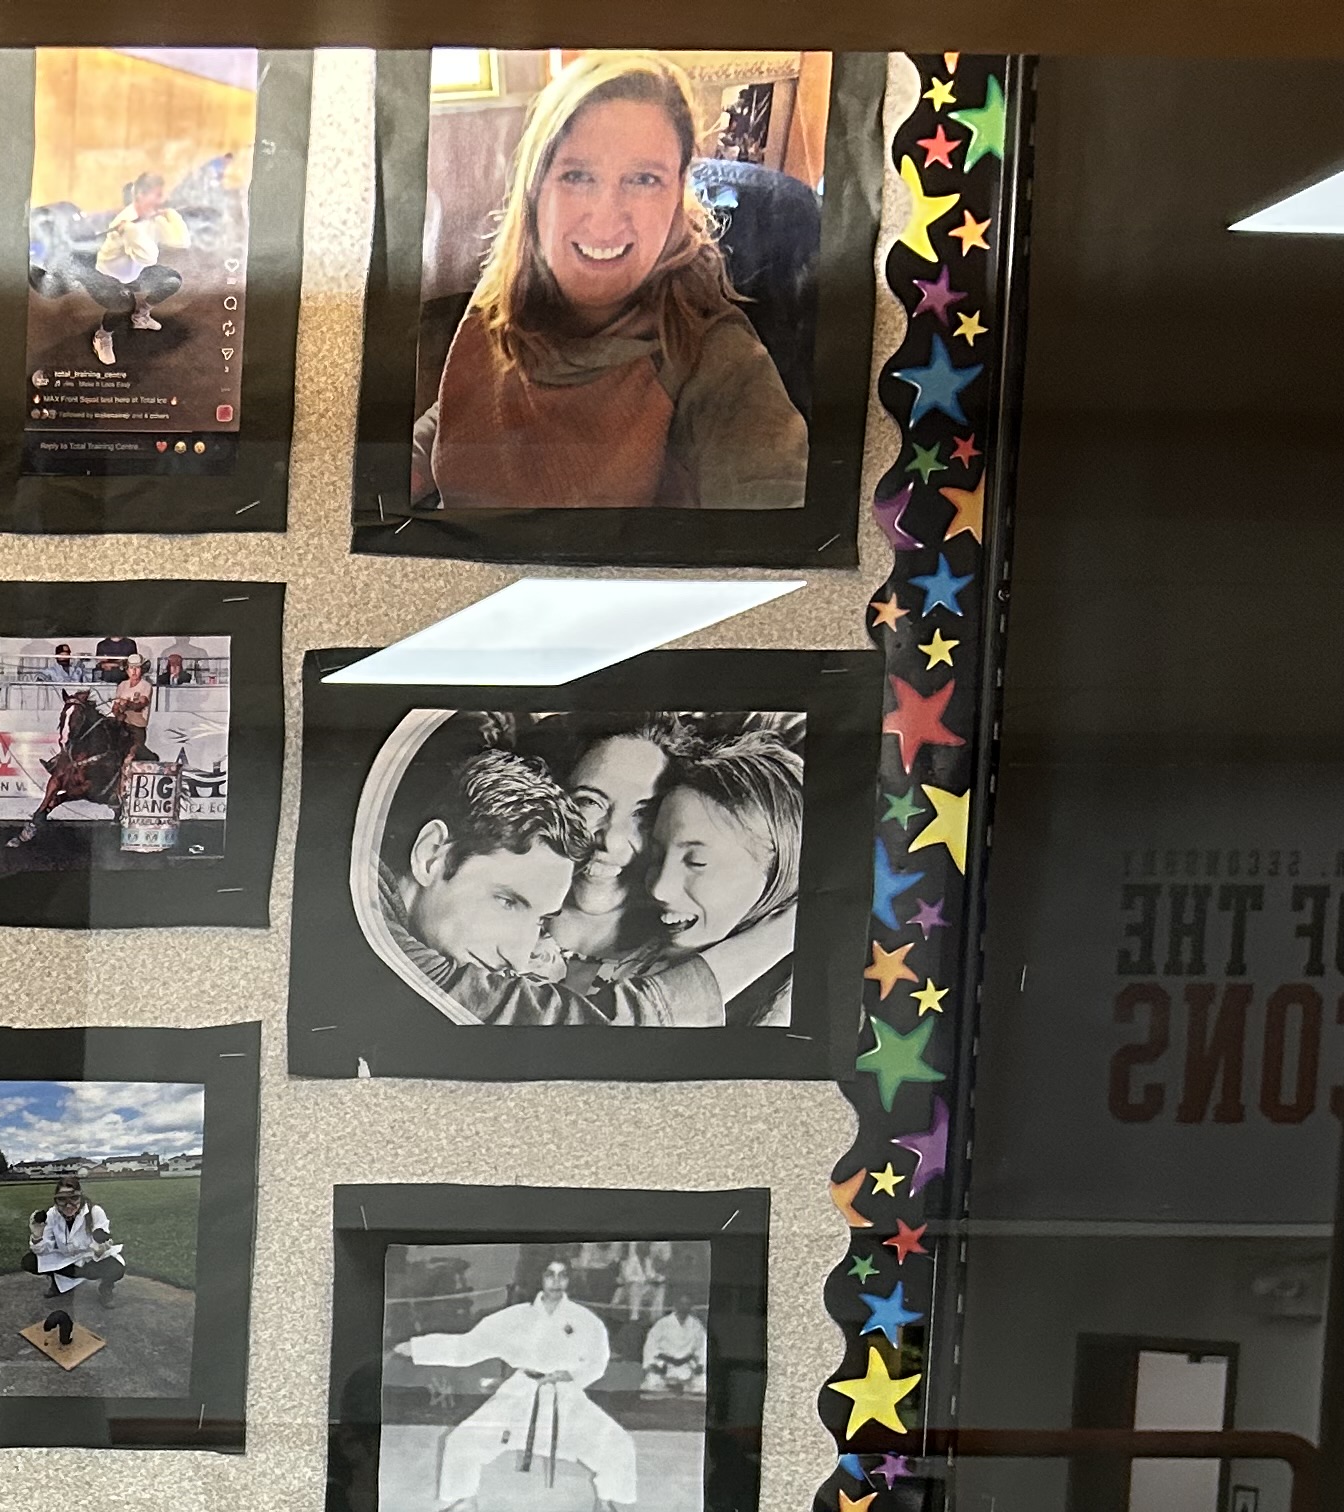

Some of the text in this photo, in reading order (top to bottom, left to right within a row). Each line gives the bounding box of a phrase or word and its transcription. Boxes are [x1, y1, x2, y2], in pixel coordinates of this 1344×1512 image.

[69, 442, 86, 450] Total
[134, 775, 174, 800] BIG
[133, 799, 173, 814] BANG
